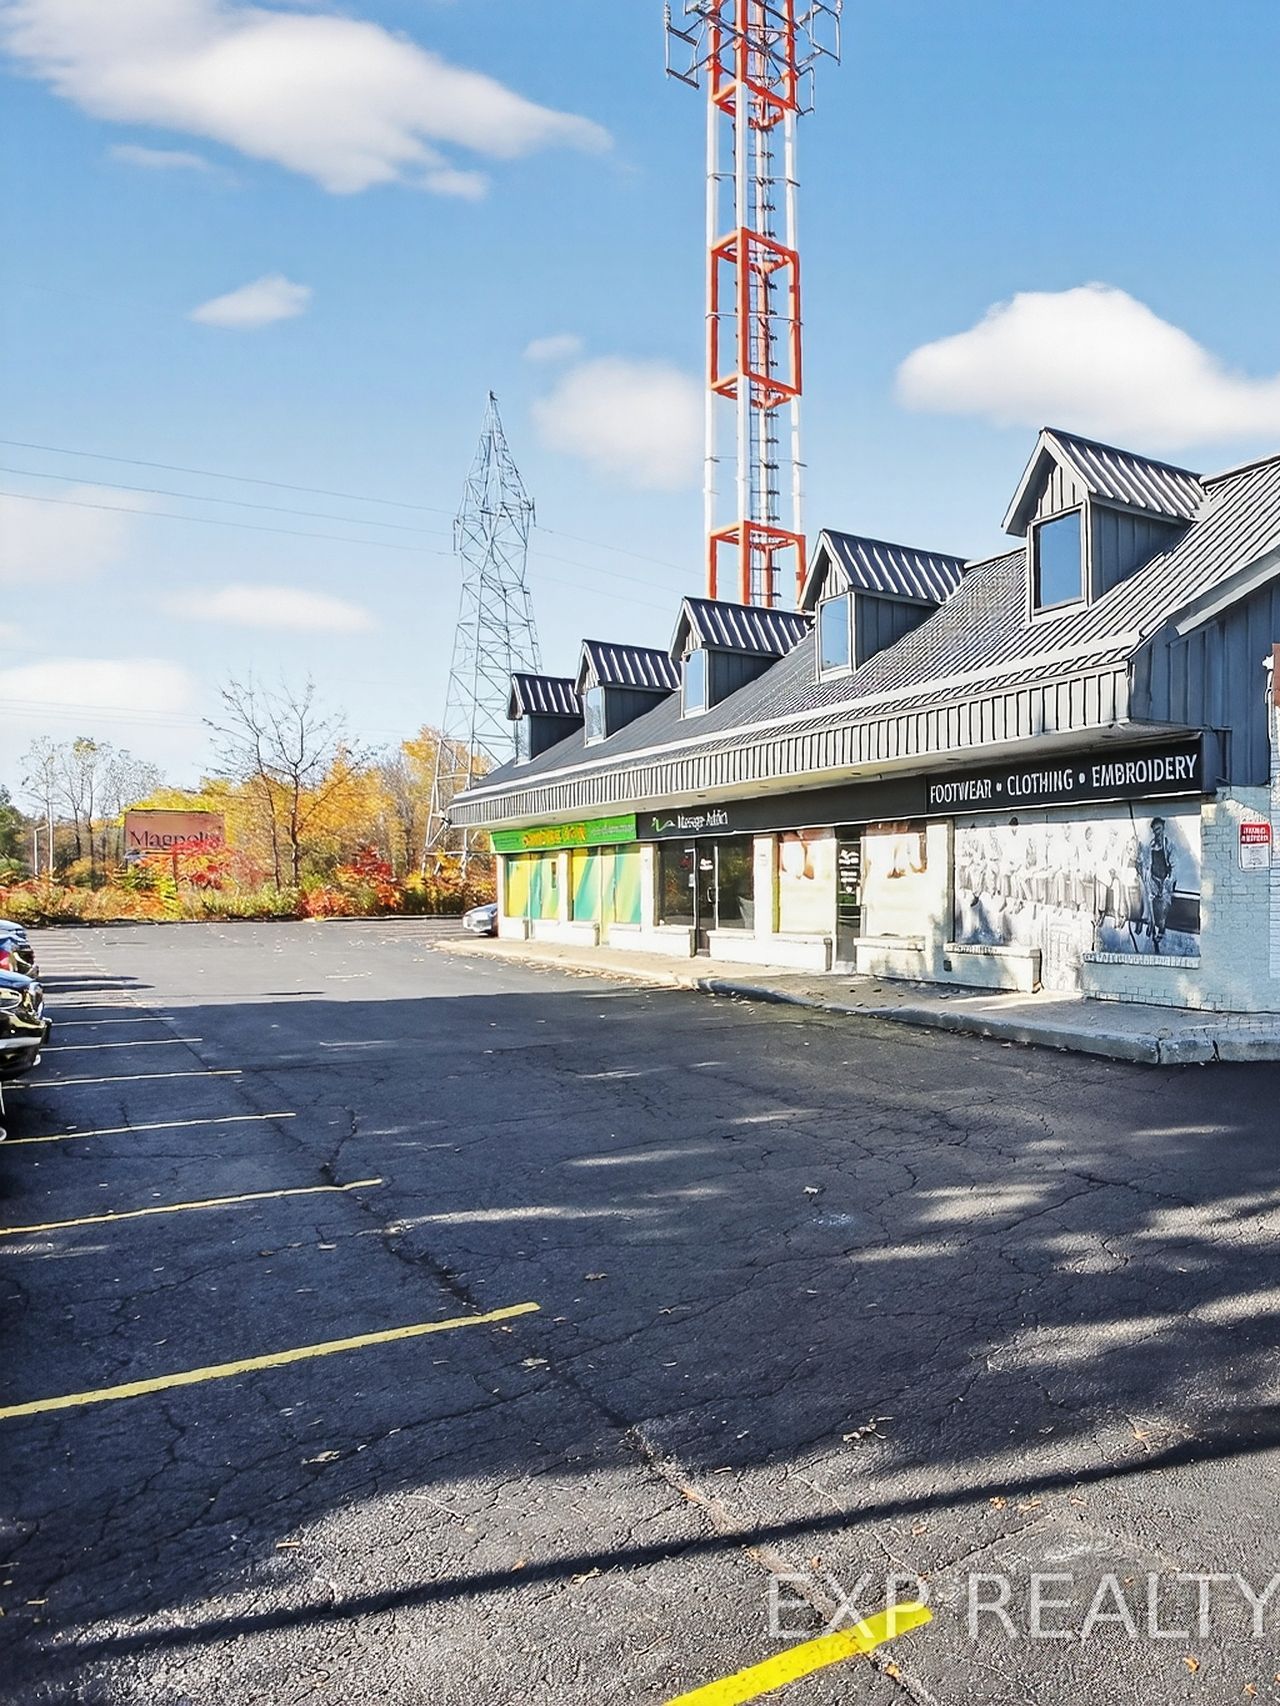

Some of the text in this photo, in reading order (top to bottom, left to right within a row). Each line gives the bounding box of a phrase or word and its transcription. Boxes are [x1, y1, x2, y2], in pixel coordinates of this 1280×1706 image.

[930, 755, 1197, 803] FOOTWEAR CLOTHING EMBROIDERY
[130, 831, 221, 848] Magnol
